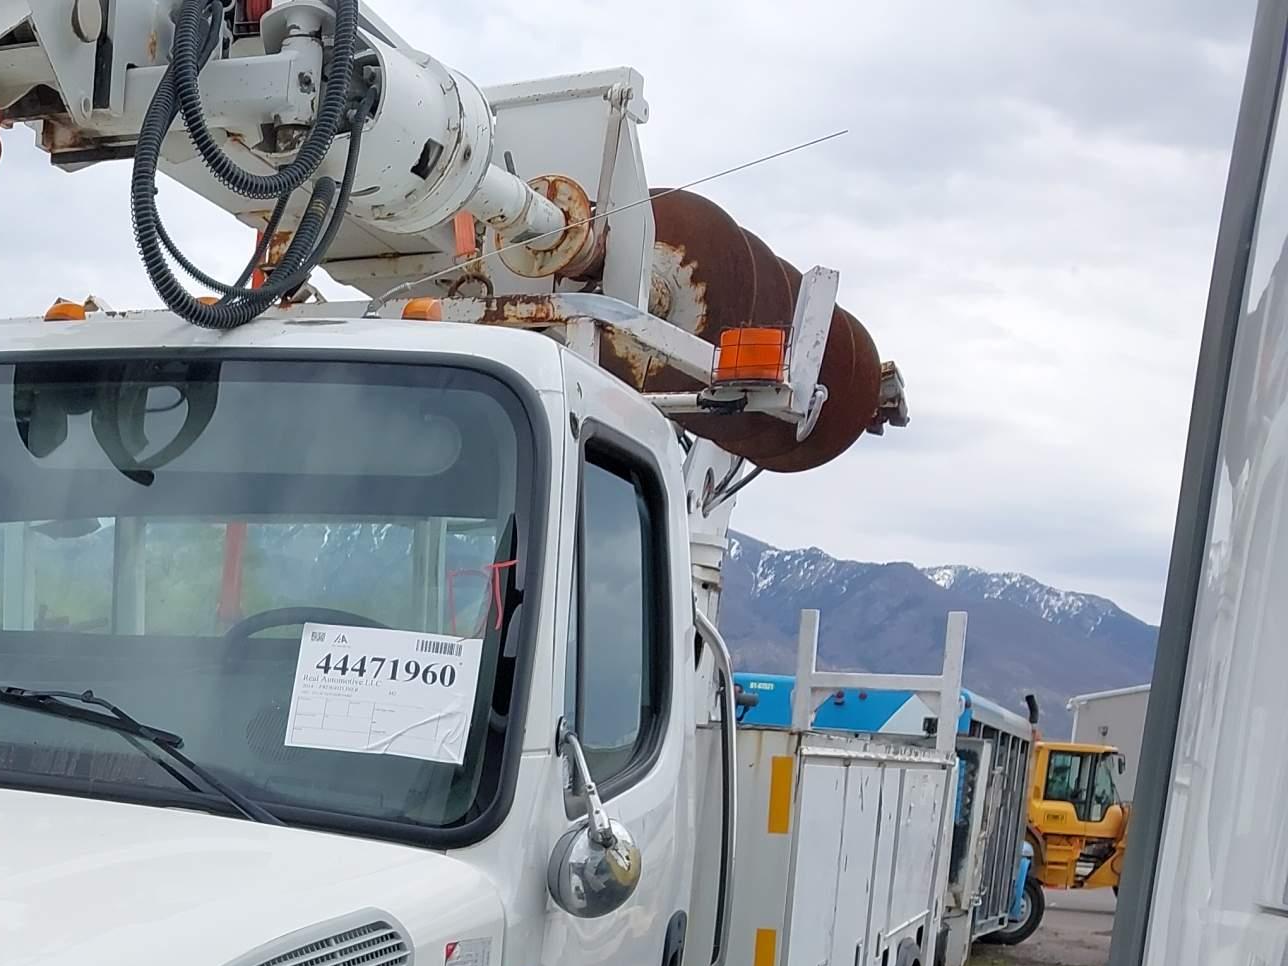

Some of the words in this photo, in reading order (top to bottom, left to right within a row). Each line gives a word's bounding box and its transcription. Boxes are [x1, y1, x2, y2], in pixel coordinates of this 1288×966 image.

[303, 674, 319, 682] Real
[321, 676, 365, 686] Automotive
[316, 652, 456, 688] 44471960
